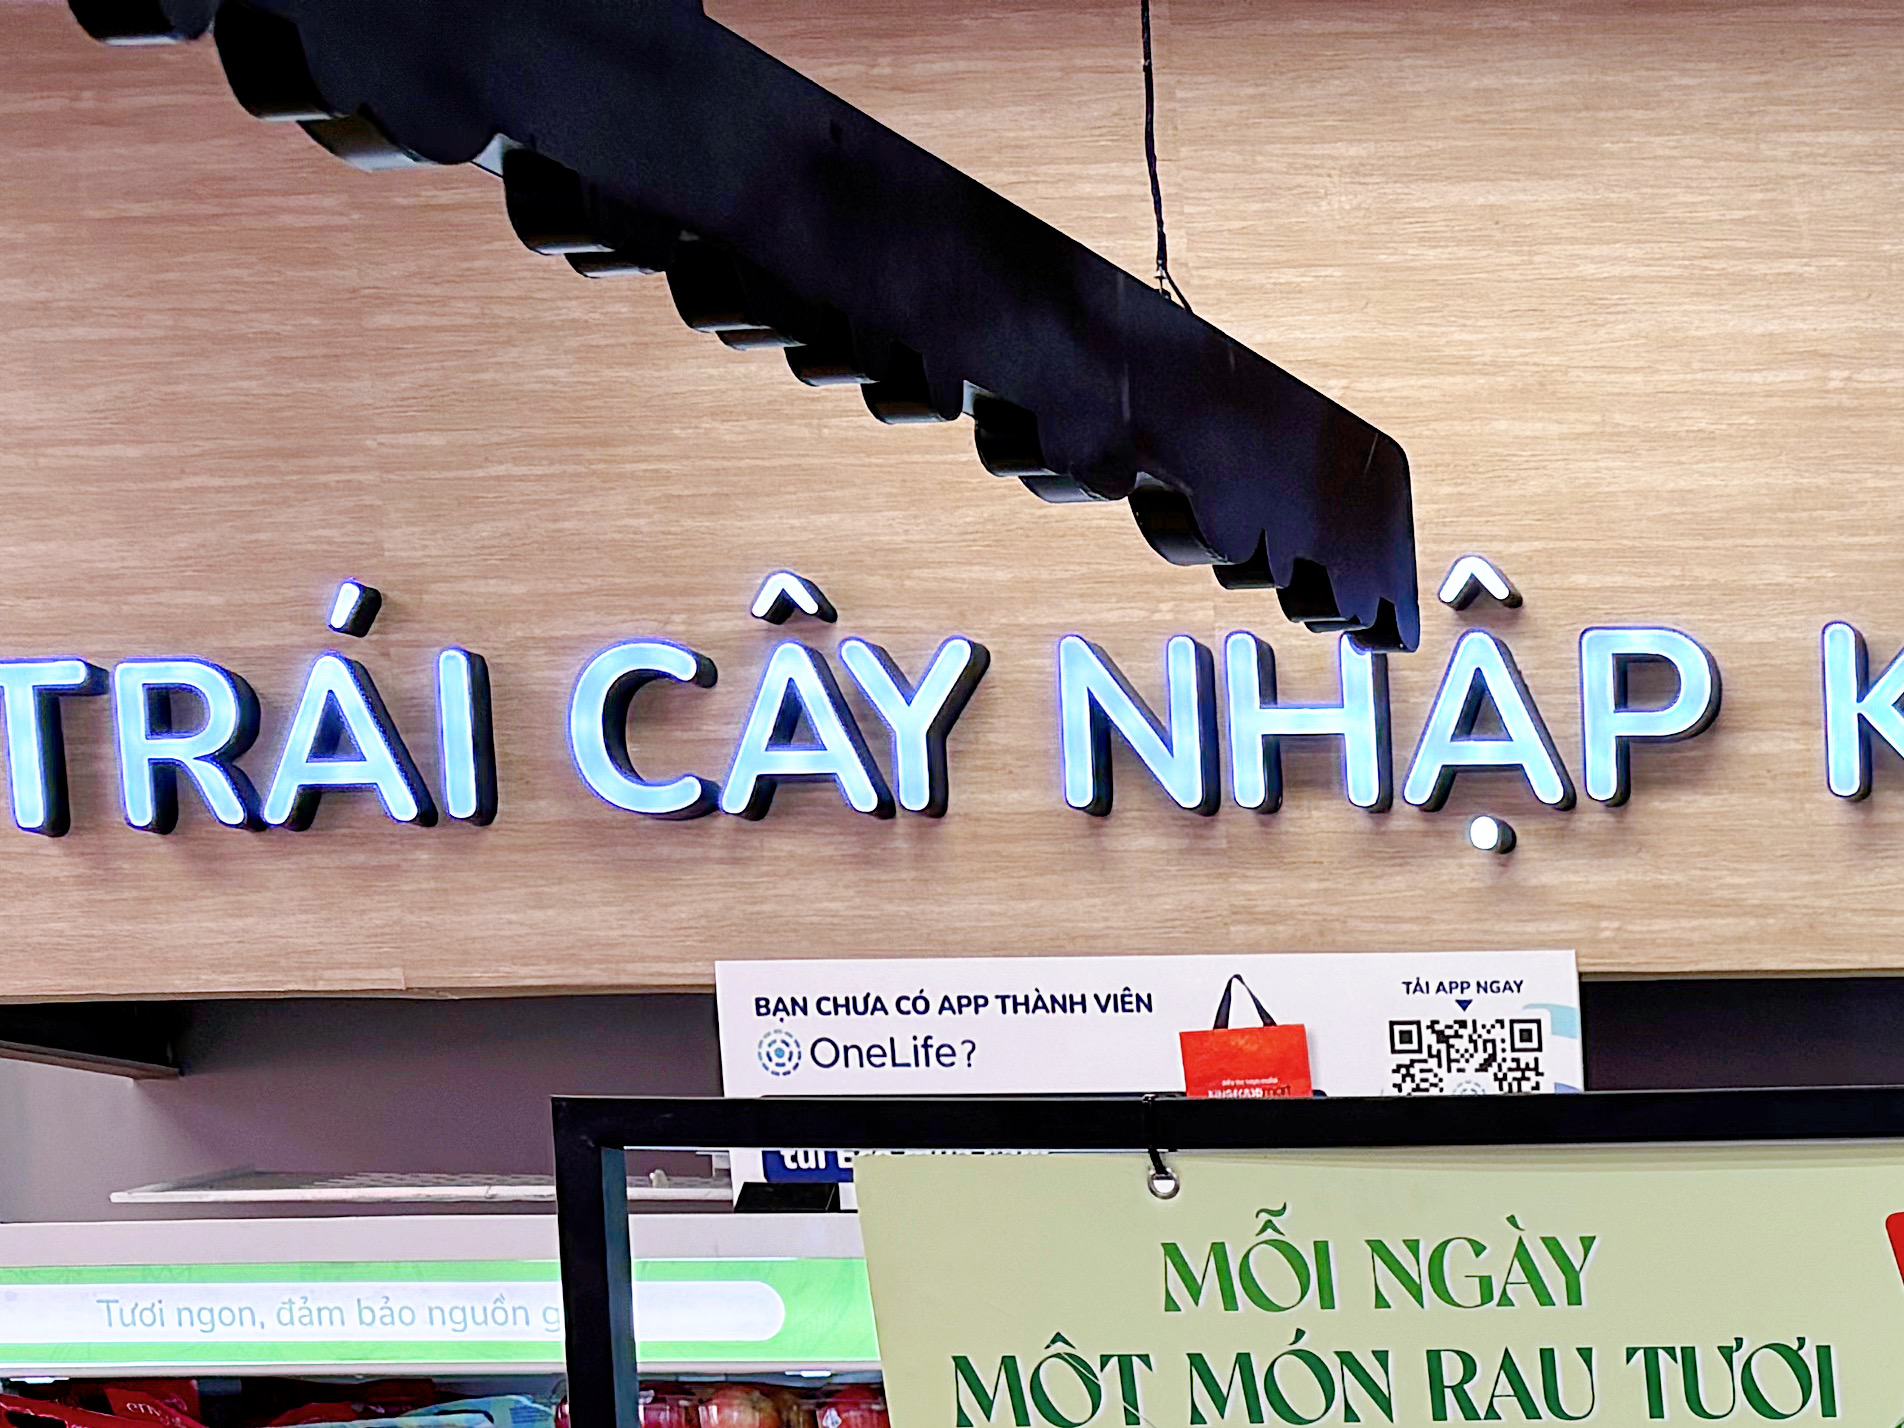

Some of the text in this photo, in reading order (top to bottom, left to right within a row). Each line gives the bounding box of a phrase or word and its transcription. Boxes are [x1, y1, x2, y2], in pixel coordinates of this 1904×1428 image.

[0, 578, 496, 836] TRÁI
[568, 568, 990, 820] CÂY
[1056, 553, 1724, 856] NHẬP
[754, 986, 1153, 1024] BẠN CHƯA CÓ APP THÀNH VIÊN
[1434, 980, 1471, 996] APP
[1475, 979, 1524, 996] NGAY
[1161, 1202, 1598, 1314] MỖI NGÀY
[96, 1298, 165, 1328] Tươi
[276, 1296, 346, 1327] đảm
[358, 1295, 416, 1327] bảo
[428, 1293, 531, 1333] nguồn
[1186, 1326, 1398, 1428] MÓN
[1425, 1346, 1598, 1424] RAU
[1624, 1334, 1842, 1424] TƯƠI
